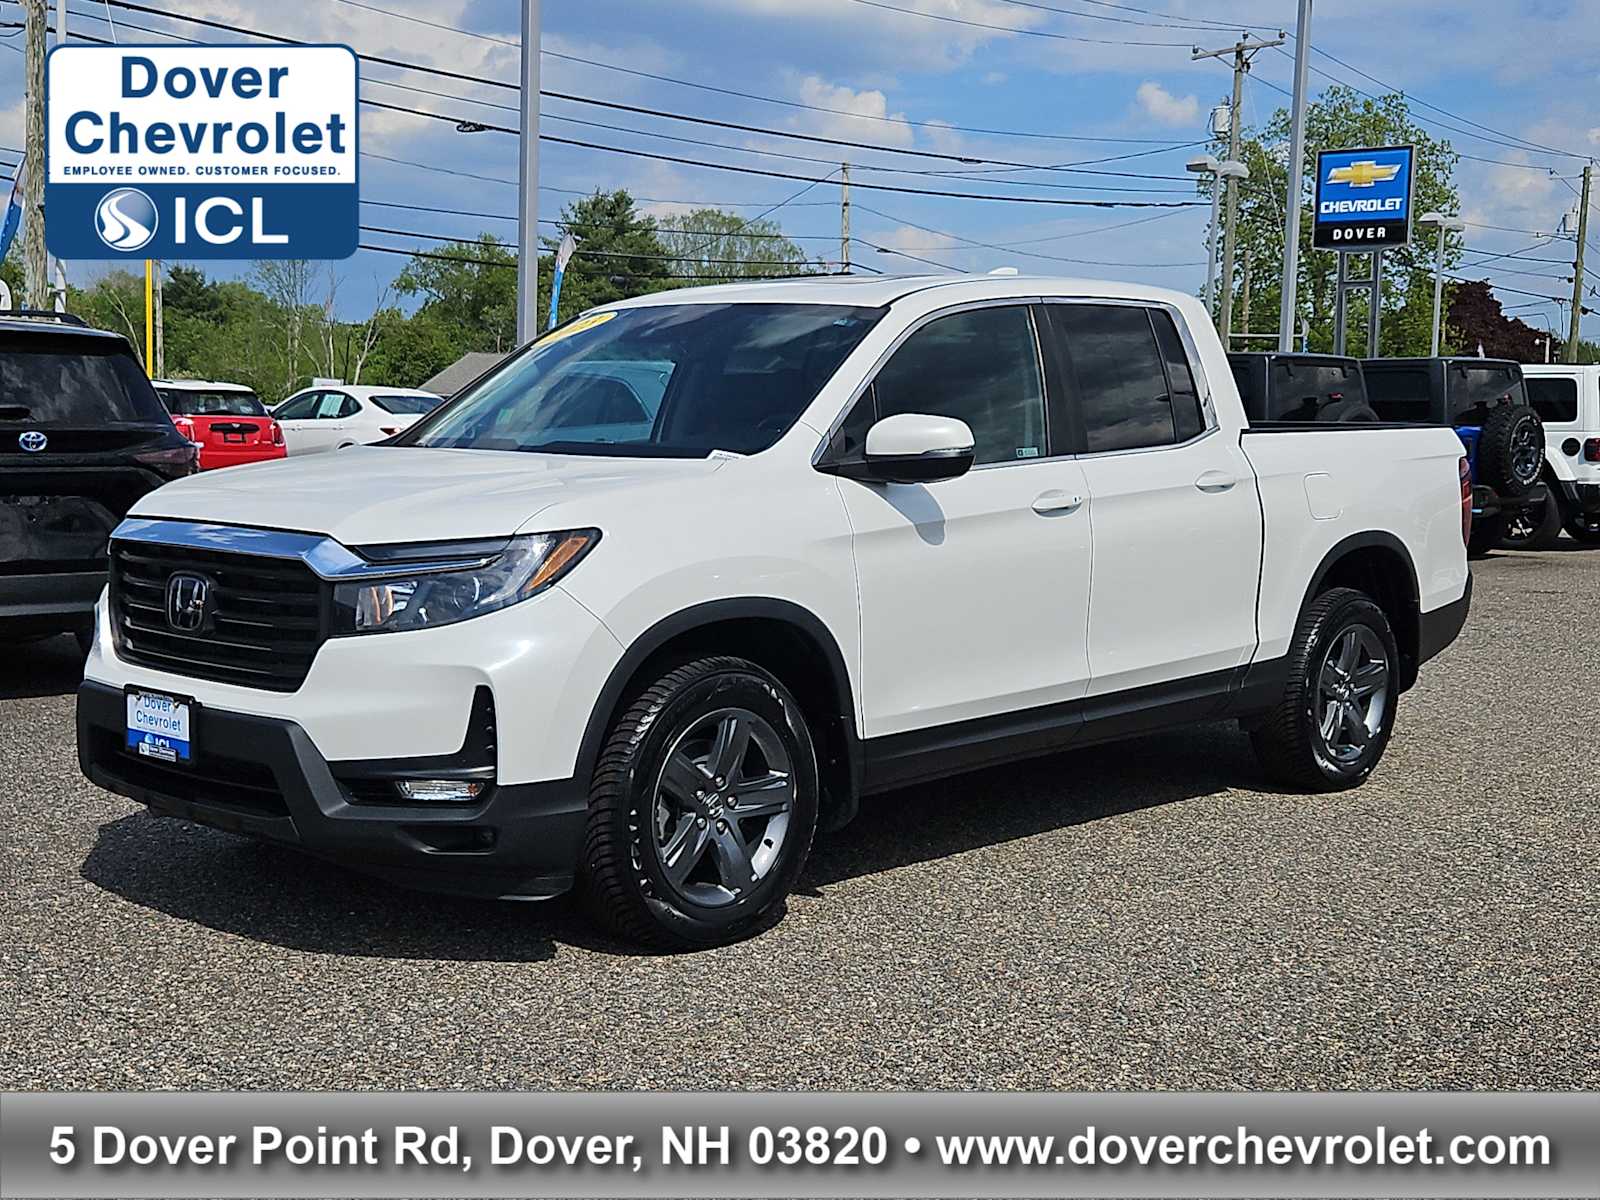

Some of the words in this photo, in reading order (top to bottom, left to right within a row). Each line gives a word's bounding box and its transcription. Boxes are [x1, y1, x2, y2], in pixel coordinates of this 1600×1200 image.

[1320, 198, 1403, 214] CHEVROLET
[1333, 227, 1386, 240] DOVER
[144, 697, 172, 712] Dover
[136, 710, 181, 731] Chevrolet
